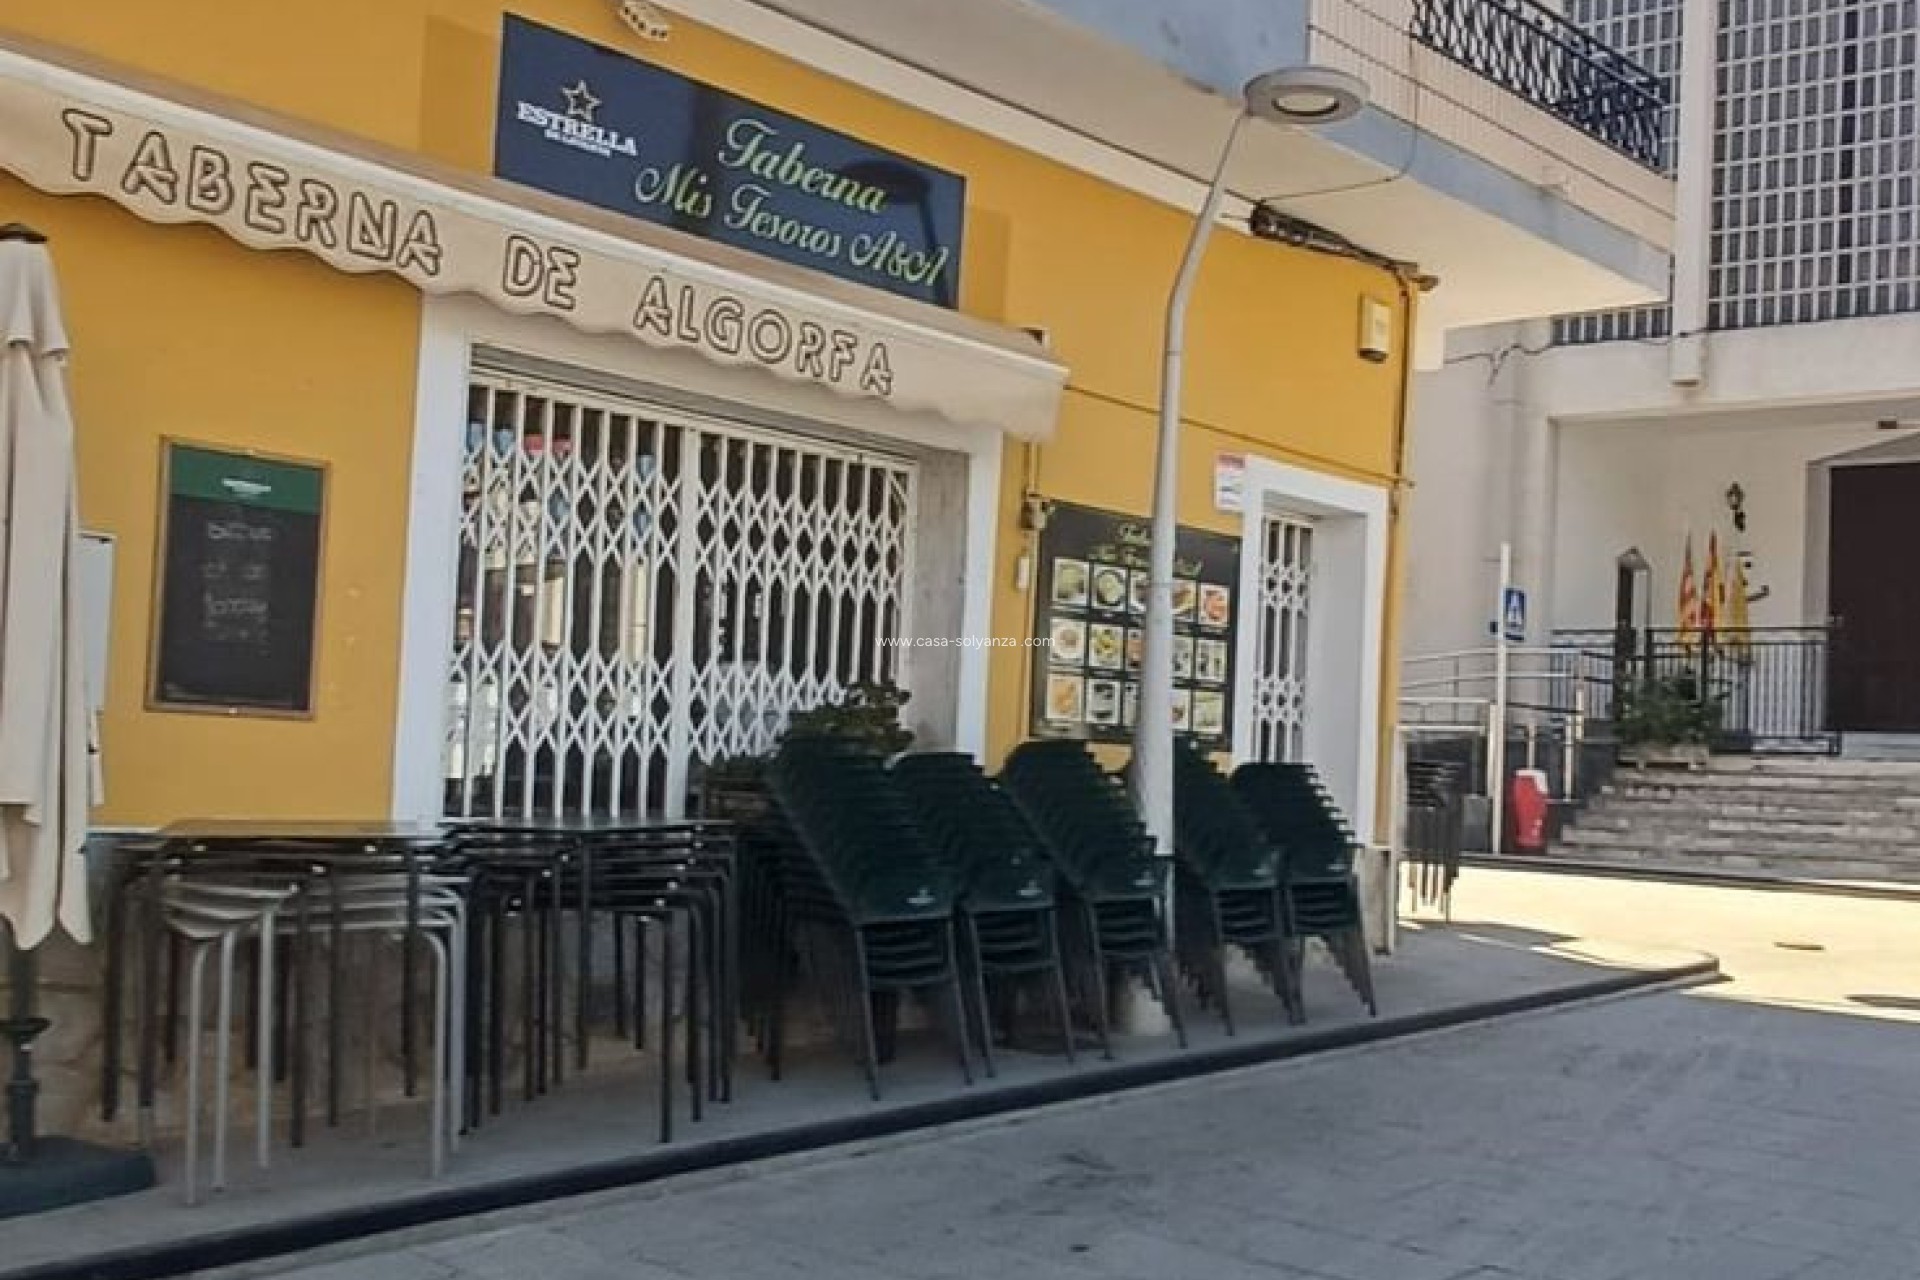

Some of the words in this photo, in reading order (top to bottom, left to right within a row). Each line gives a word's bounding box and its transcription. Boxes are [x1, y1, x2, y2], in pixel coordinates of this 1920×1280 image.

[518, 101, 637, 156] ESTRELLA
[718, 118, 887, 214] Taberna
[62, 108, 442, 276] TABERNA
[502, 234, 581, 311] DE
[633, 275, 893, 396] ALGORFA
[635, 163, 712, 218] Mis
[724, 183, 842, 258] Tesoros
